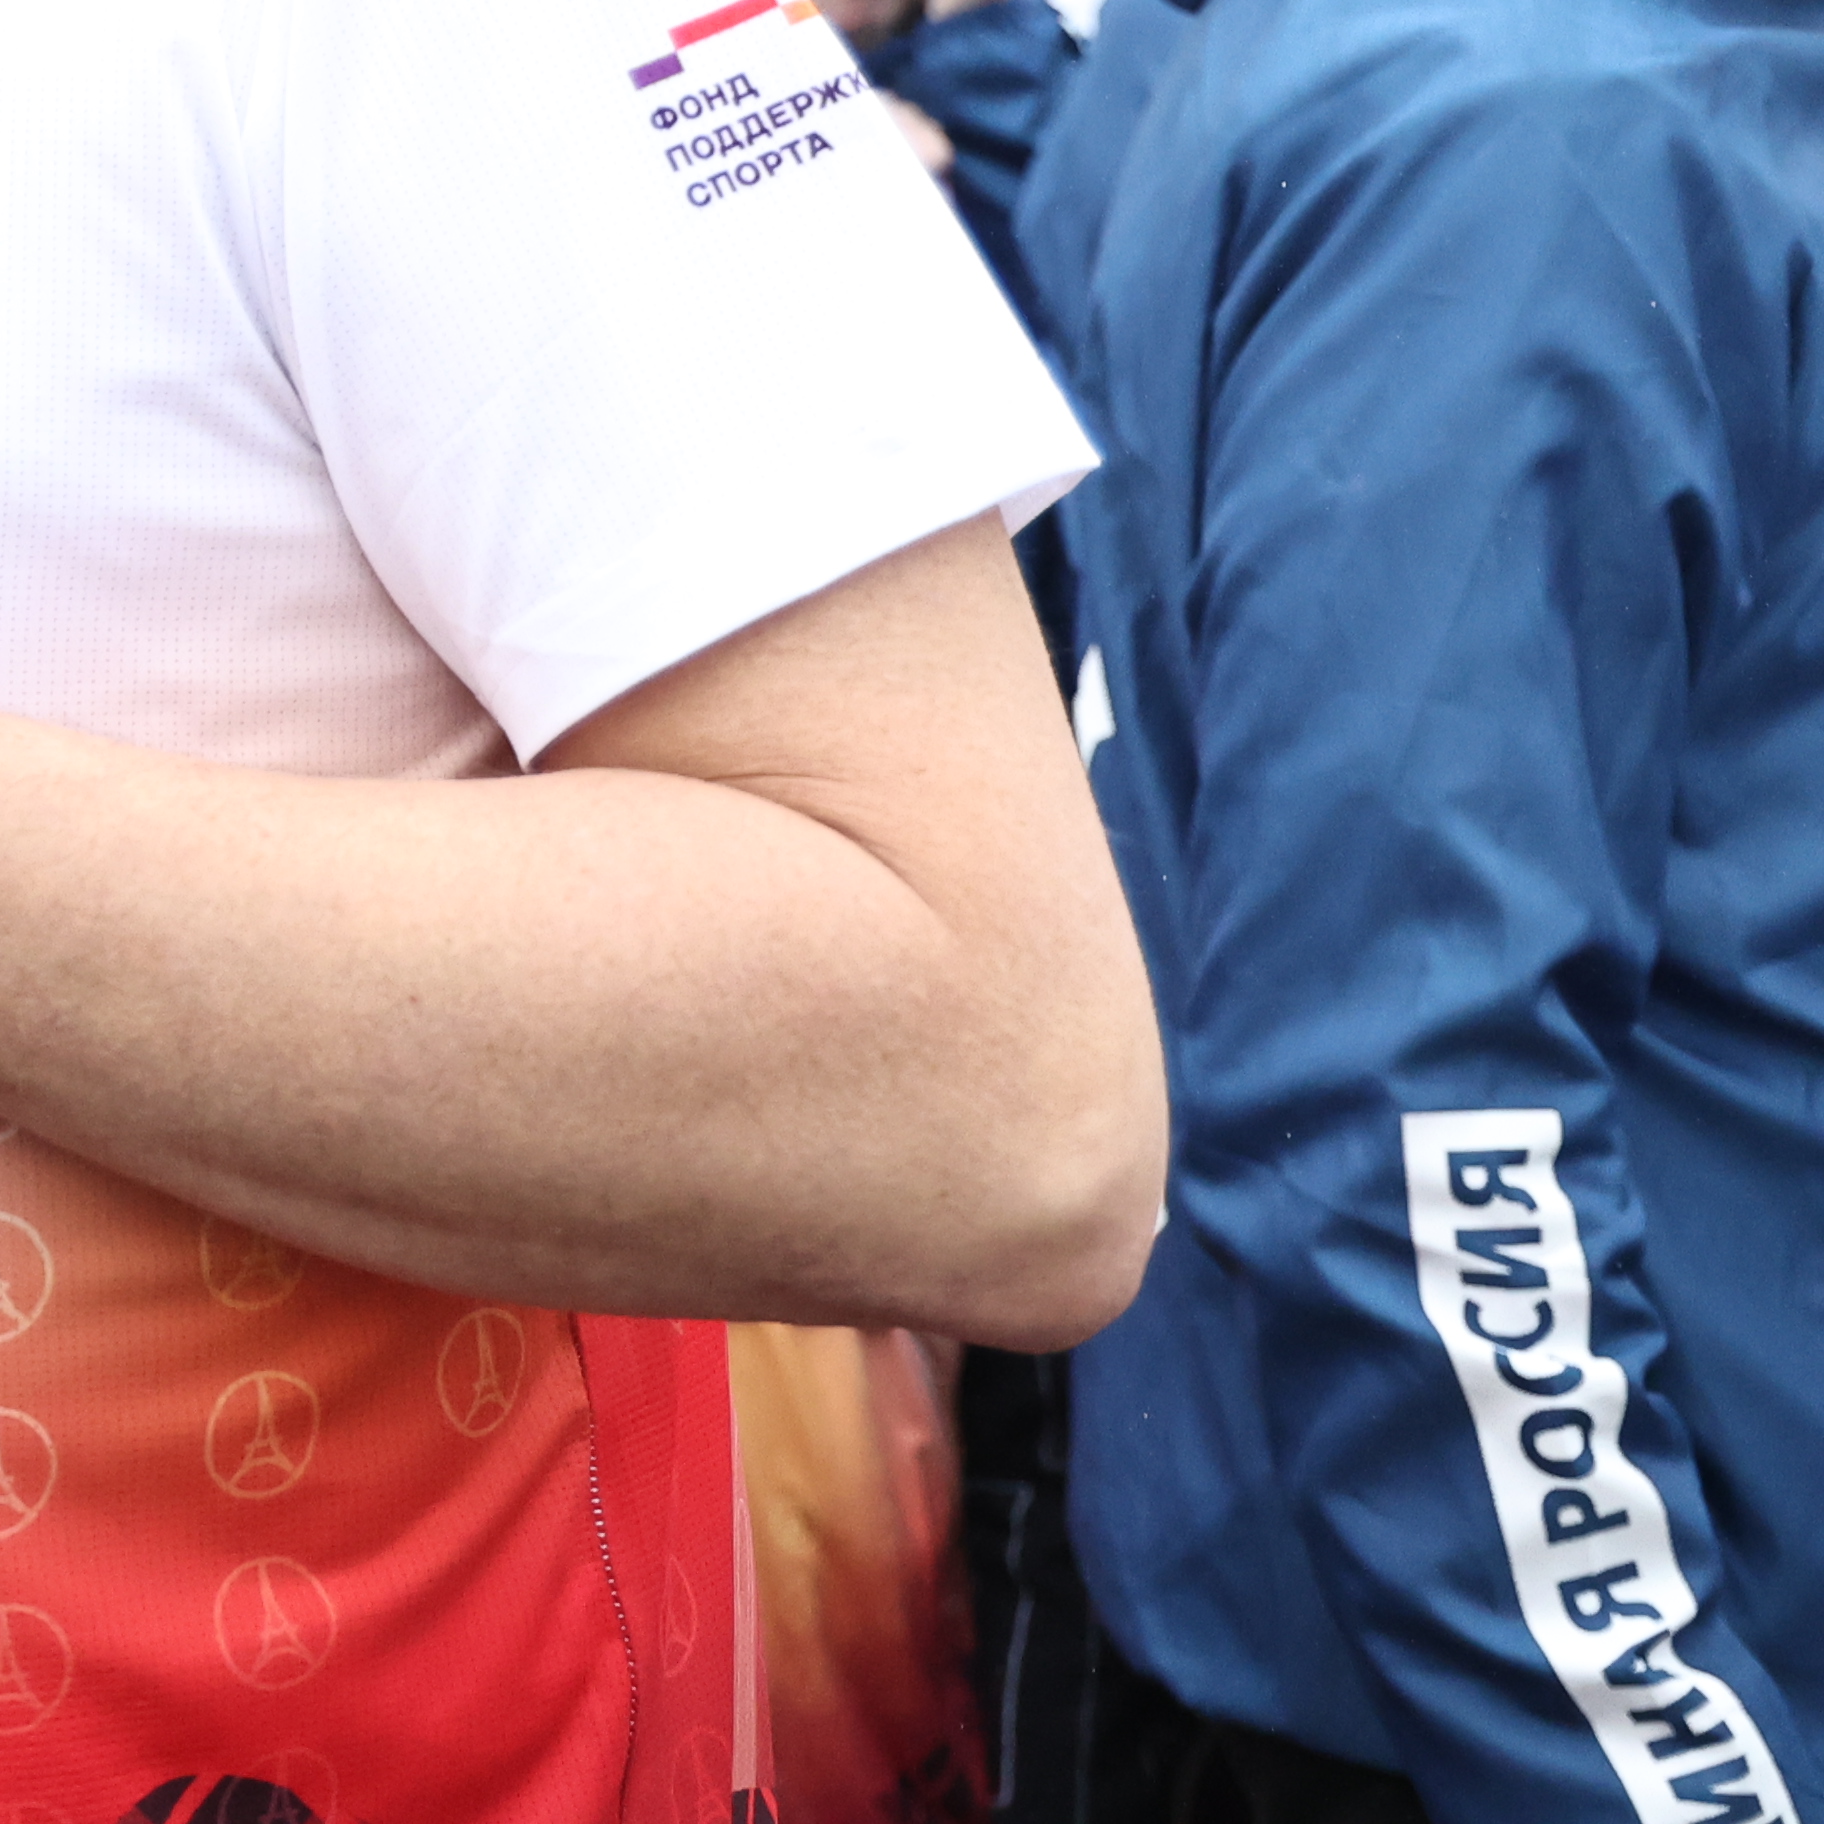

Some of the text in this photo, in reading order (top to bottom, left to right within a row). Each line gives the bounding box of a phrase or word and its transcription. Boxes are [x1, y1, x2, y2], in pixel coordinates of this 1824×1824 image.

[650, 72, 760, 130] ФОНД
[664, 70, 868, 172] ПОДДЕРЖК
[687, 131, 834, 207] СПОРТА
[1448, 1149, 1786, 1824] ИНАЯ РОССИЯ
